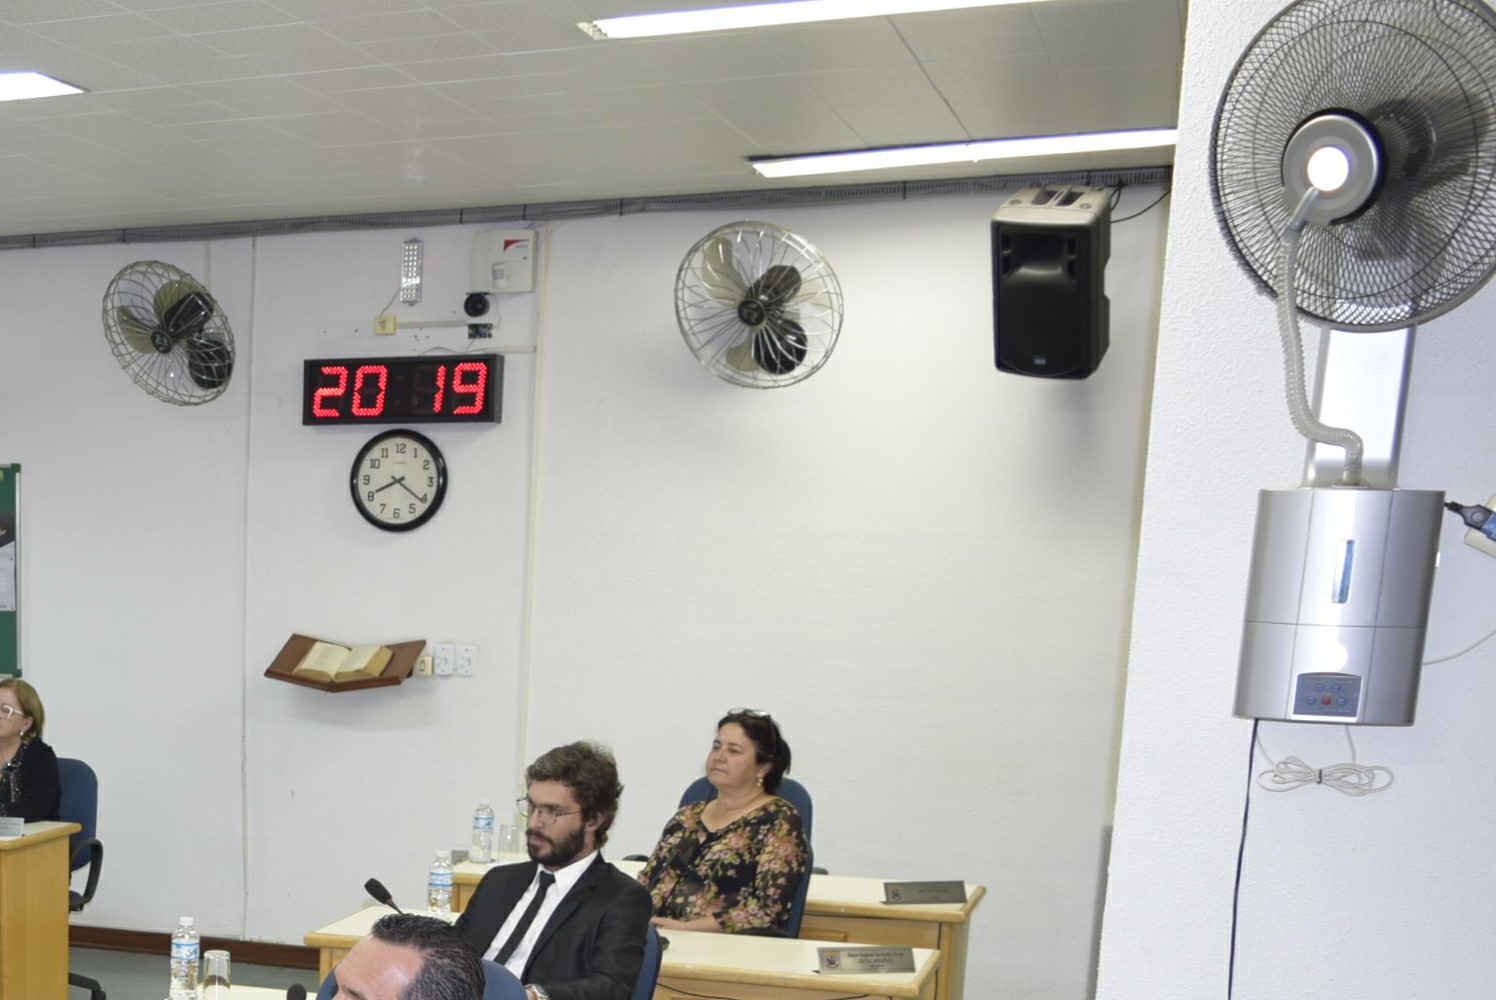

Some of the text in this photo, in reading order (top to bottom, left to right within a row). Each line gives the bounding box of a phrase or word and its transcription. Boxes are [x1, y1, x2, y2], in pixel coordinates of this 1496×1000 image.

[312, 362, 488, 417] 20 19
[381, 448, 388, 458] 11
[395, 443, 406, 454] 12
[413, 448, 418, 458] 1
[370, 459, 380, 469] 10
[423, 459, 430, 470] 2
[363, 475, 370, 485] 9
[427, 476, 434, 487] 3
[367, 491, 374, 502] 8
[421, 493, 428, 504] 4
[379, 504, 386, 514] 7
[393, 508, 400, 519] 6
[409, 504, 416, 514] 5
